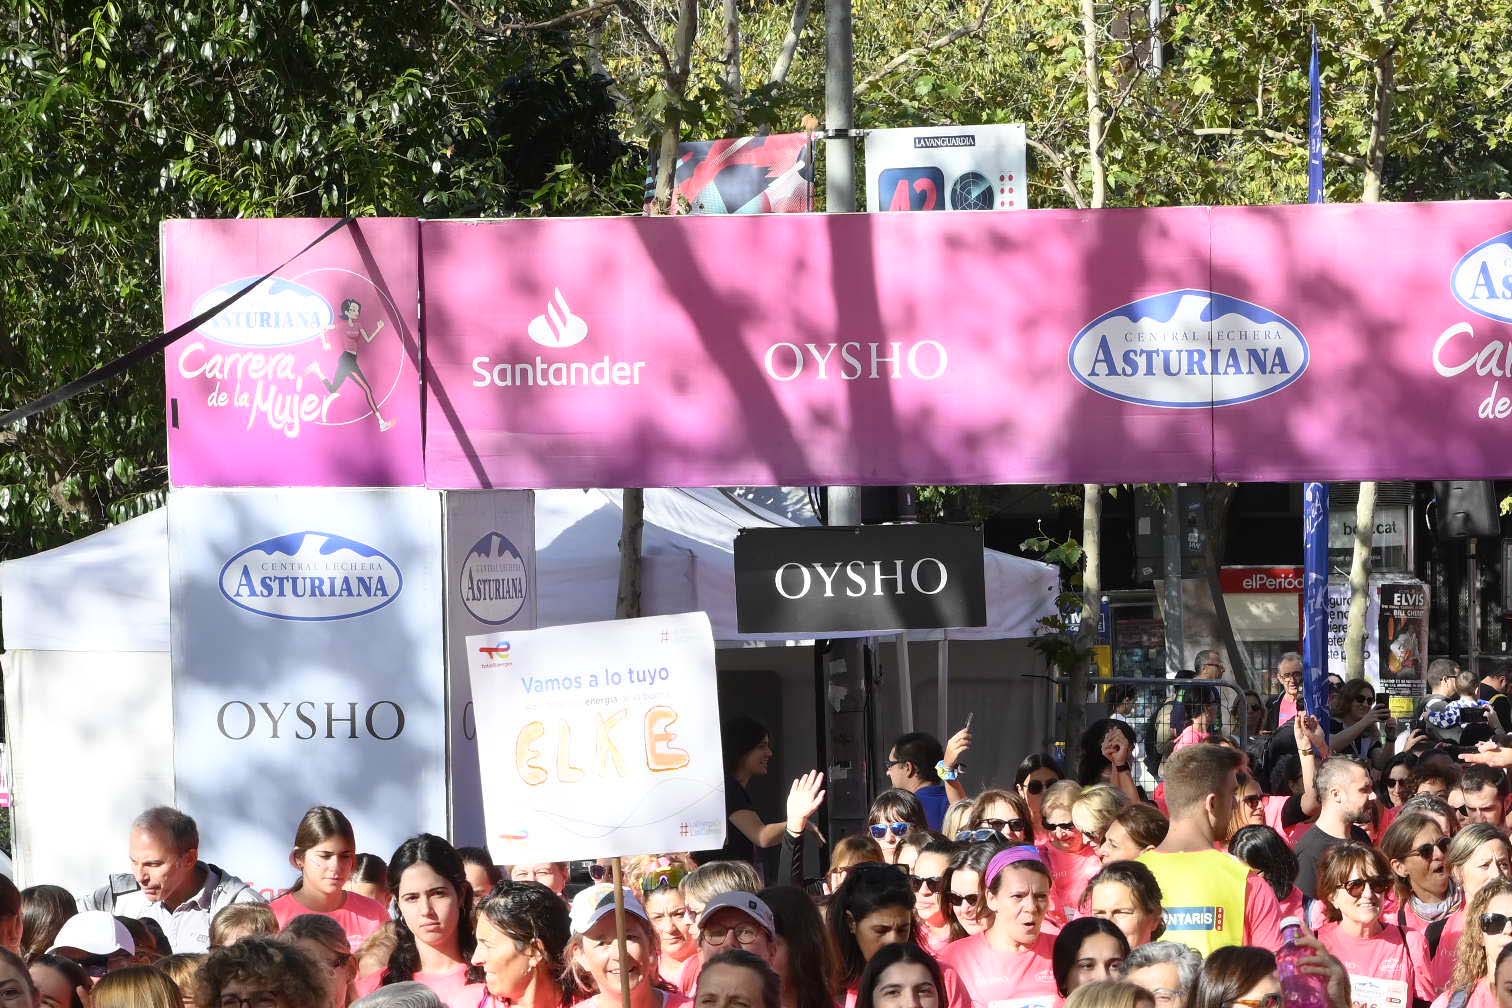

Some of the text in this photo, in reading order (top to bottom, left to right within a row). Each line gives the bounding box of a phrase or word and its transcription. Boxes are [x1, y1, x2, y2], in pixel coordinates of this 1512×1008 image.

[1124, 329, 1283, 343] CENTRAL LECHERA
[178, 343, 296, 382] Carrera
[471, 355, 646, 387] Santander
[763, 340, 949, 382] OYSHO
[1087, 334, 1291, 378] ASTURIANA
[207, 377, 342, 439] de la Mujer
[1477, 380, 1512, 419] de
[232, 563, 390, 599] ASTURIANA
[260, 561, 384, 573] CENTRAL LECHERA
[465, 565, 524, 603] ASTURIANA
[774, 557, 948, 600] OYSHO
[1393, 593, 1424, 606] ELVIS
[521, 666, 670, 694] Vamos a lo tuyo
[216, 699, 406, 741] OYSHO
[515, 704, 691, 787] ELKE
